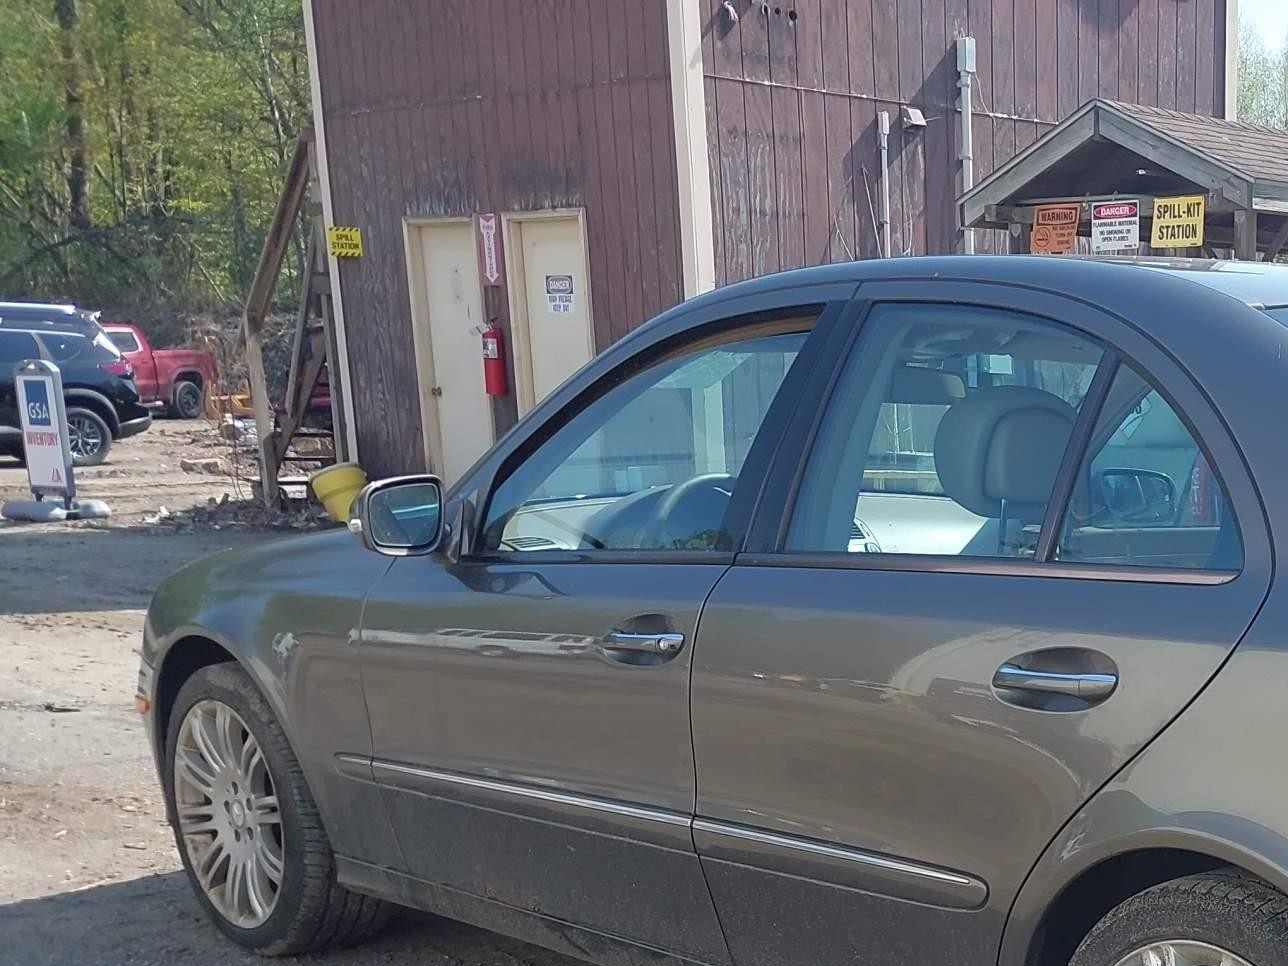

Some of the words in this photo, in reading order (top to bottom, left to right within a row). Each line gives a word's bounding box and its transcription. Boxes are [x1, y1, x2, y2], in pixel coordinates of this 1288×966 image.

[1041, 210, 1074, 222] WARNING
[1100, 206, 1130, 216] DANGER
[1156, 201, 1202, 219] SPILL-KIT
[1158, 223, 1198, 241] STATION
[332, 241, 360, 249] STATION
[550, 280, 570, 289] DANGER
[28, 403, 48, 418] GSA
[26, 432, 58, 446] INVENTORY
